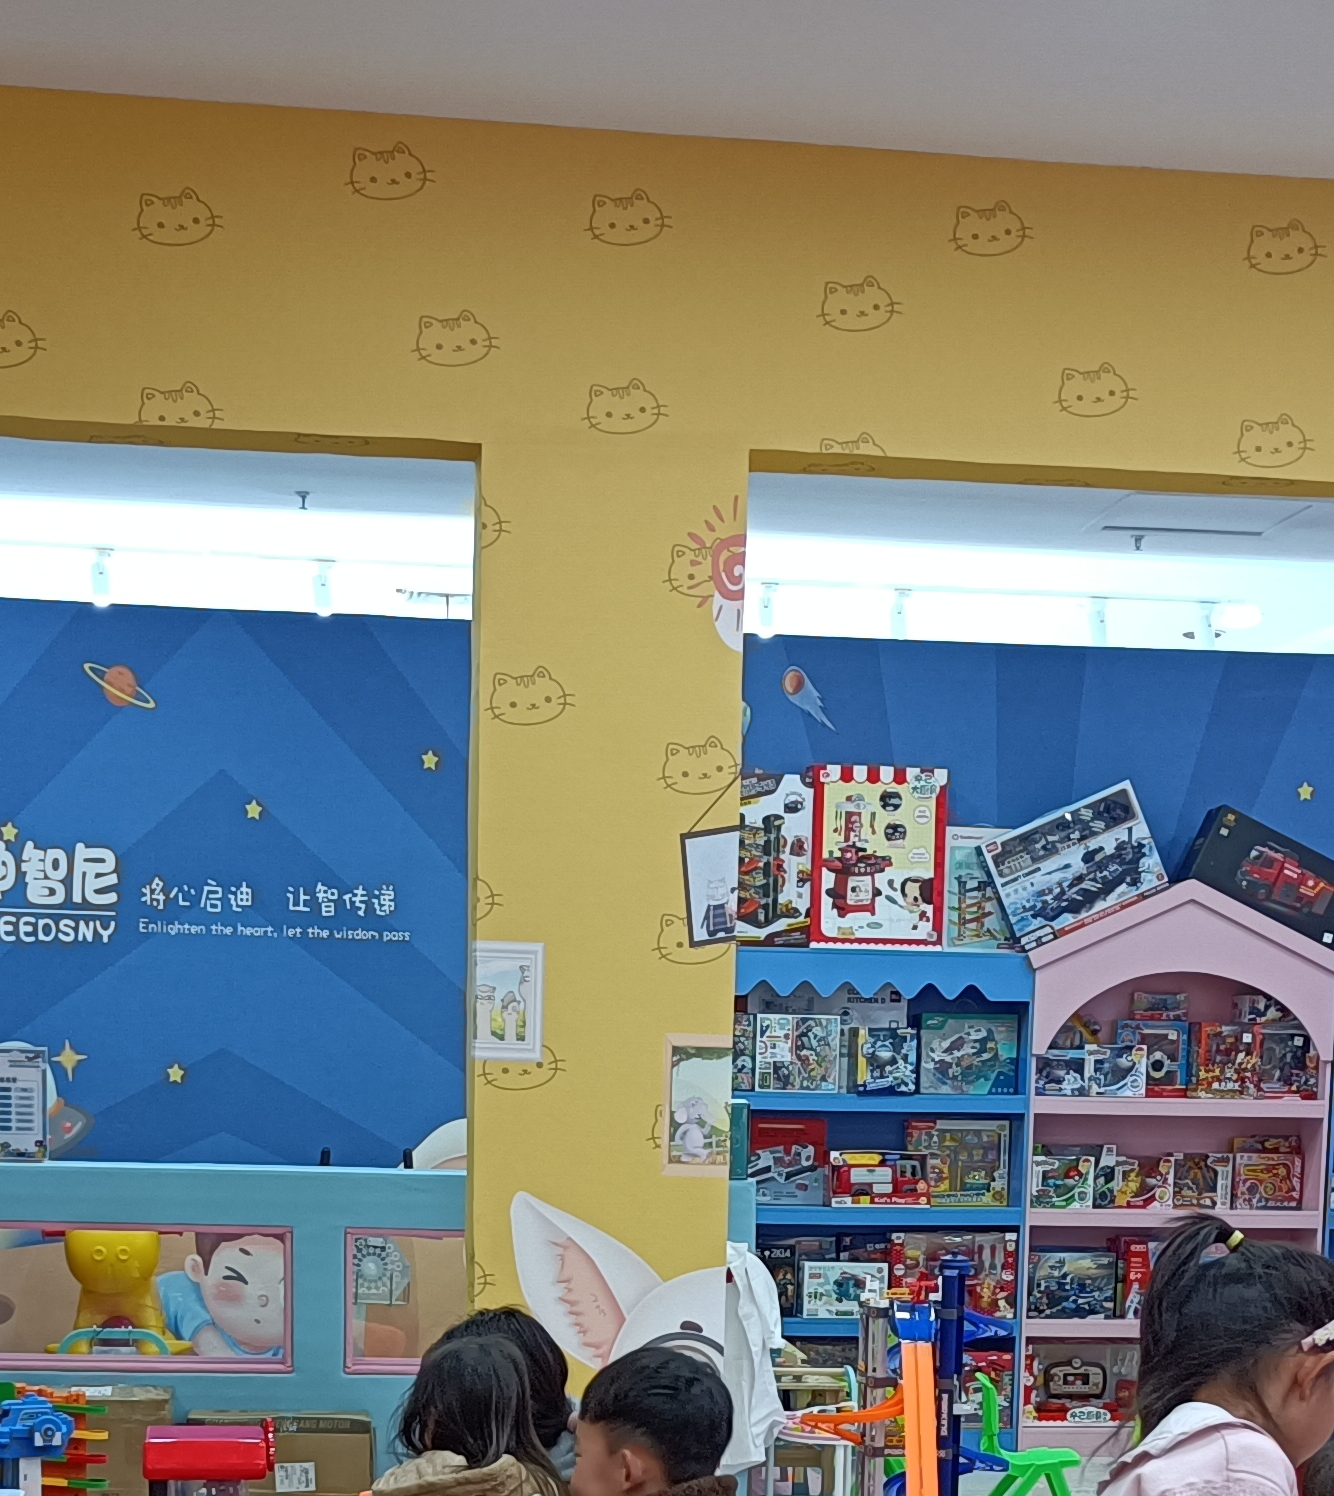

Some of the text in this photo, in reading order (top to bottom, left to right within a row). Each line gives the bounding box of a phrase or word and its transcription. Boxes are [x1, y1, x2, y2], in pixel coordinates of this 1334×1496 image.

[140, 876, 396, 917] 将心启迪 让智传递
[139, 918, 207, 936] Enlighten
[210, 922, 234, 936] the
[237, 923, 278, 939] heart,
[283, 925, 303, 939] let
[306, 925, 330, 939] the
[383, 931, 411, 943] pass
